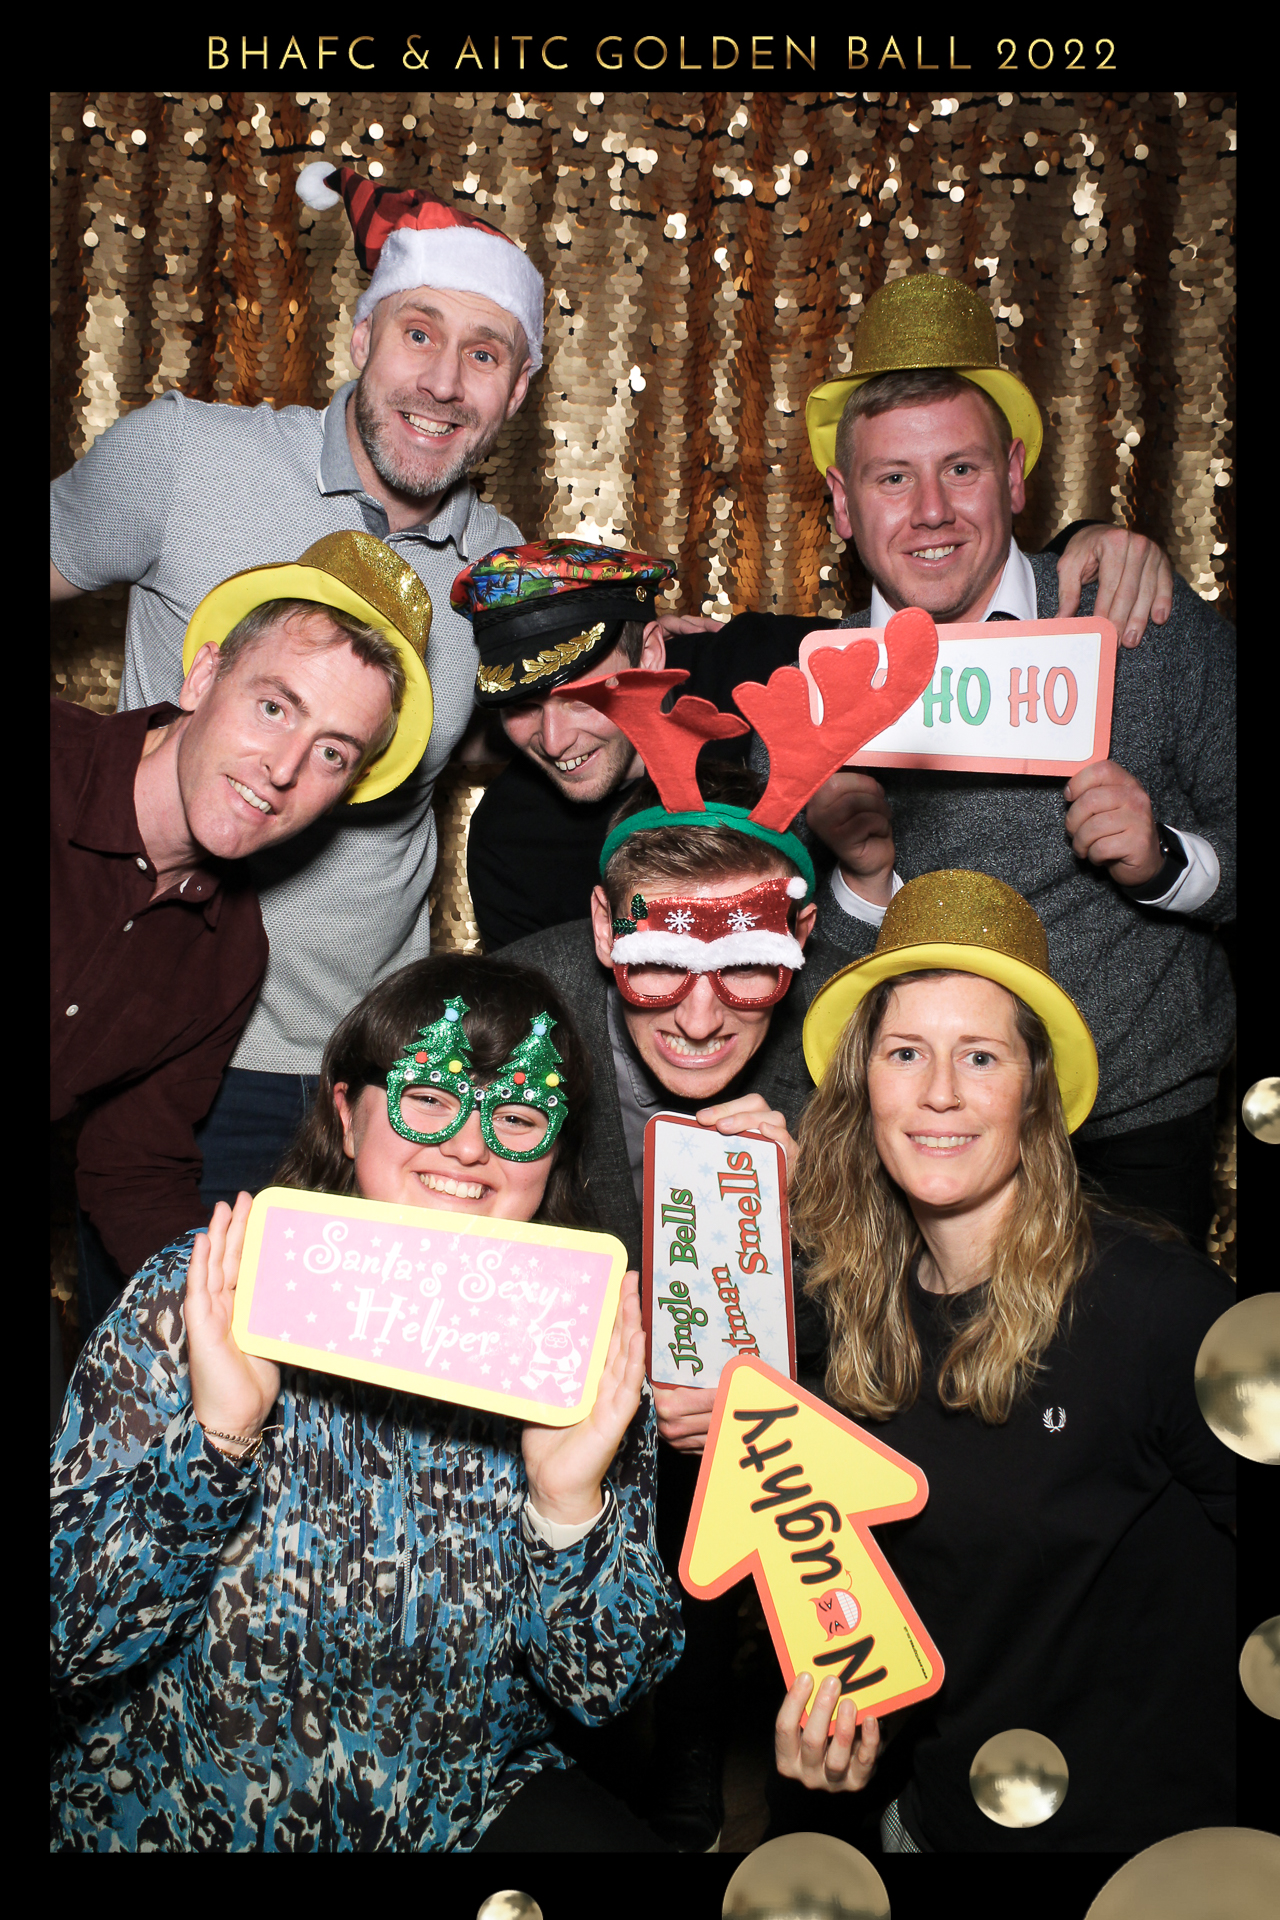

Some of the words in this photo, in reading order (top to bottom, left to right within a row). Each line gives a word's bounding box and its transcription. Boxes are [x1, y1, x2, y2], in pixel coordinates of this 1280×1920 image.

[921, 665, 991, 728] HO
[1008, 665, 1079, 728] HO
[661, 1188, 699, 1270] Bells
[717, 1151, 773, 1275] Smells
[302, 1220, 448, 1298] Santa's
[457, 1248, 561, 1324] Sexy
[346, 1284, 502, 1369] Helper
[657, 1280, 709, 1377] Jingle
